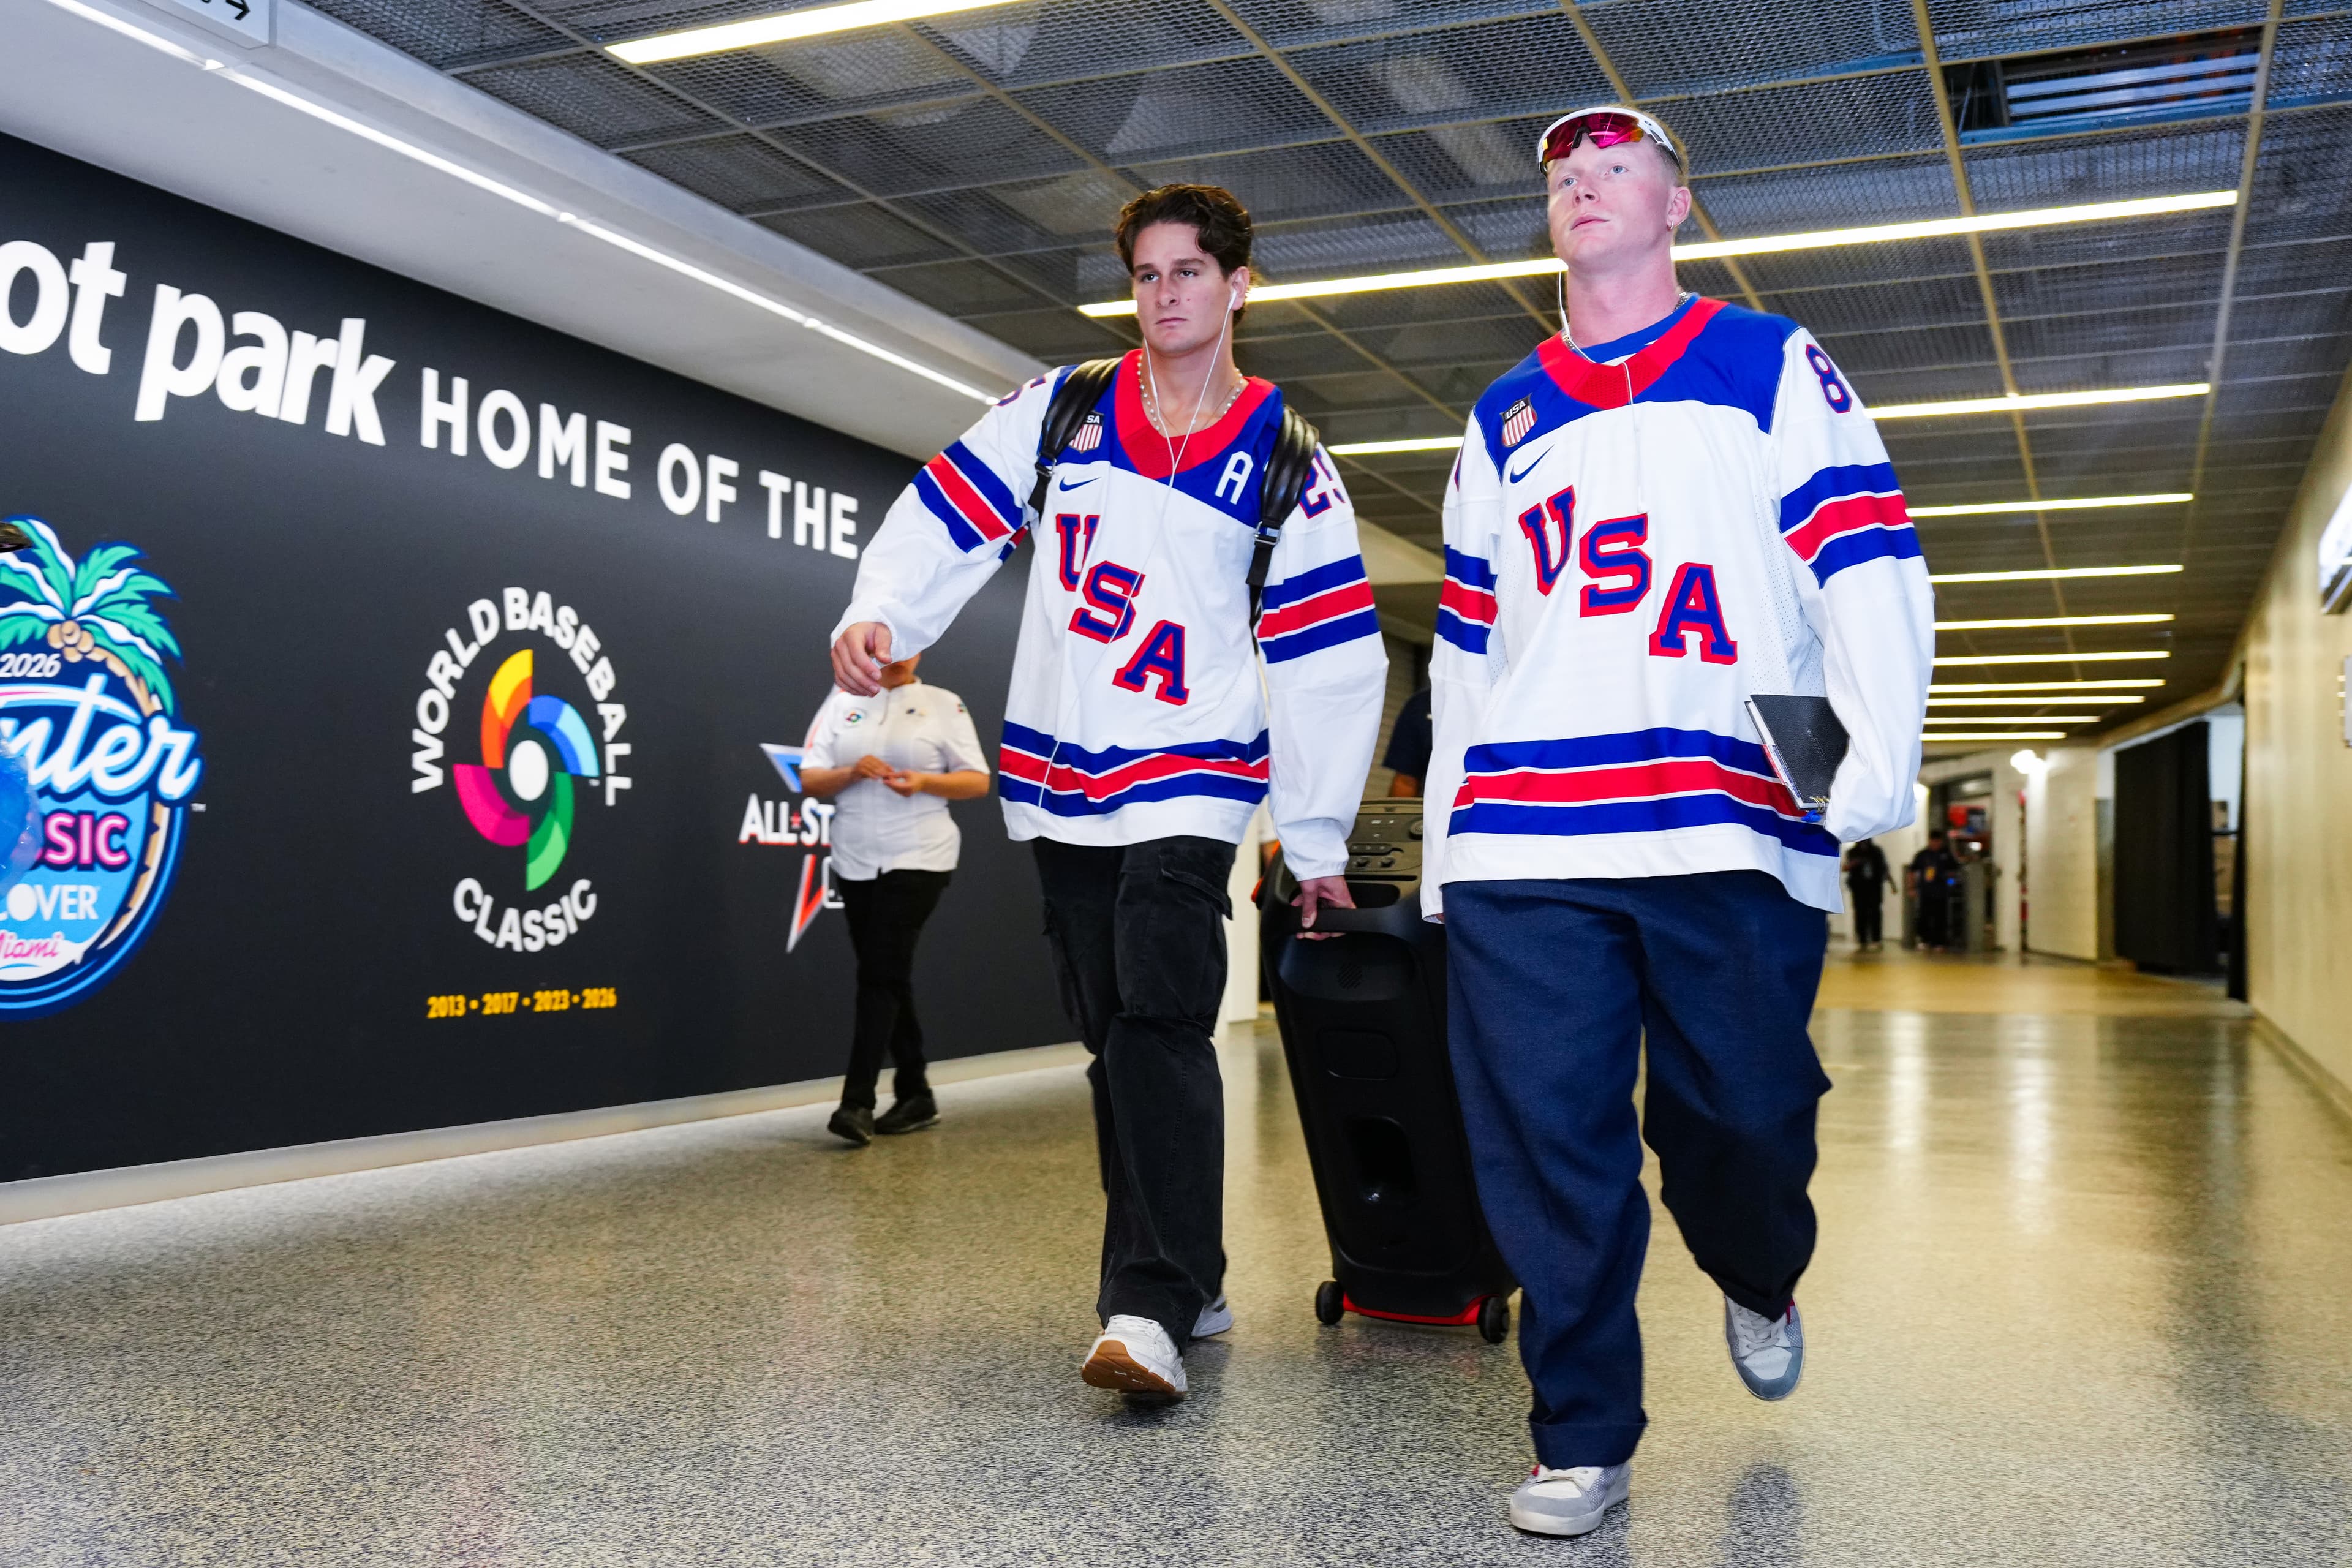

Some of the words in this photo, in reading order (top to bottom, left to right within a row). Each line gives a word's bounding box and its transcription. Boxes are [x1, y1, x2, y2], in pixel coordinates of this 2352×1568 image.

[0, 240, 127, 374] ot
[135, 284, 396, 447] park
[420, 368, 631, 499] HOME
[657, 443, 739, 522] OF
[760, 470, 858, 559] THE
[1087, 415, 1101, 424] SA
[1506, 400, 1526, 420] USA
[1215, 451, 1254, 505] A
[1518, 485, 1738, 665] USA
[1056, 513, 1189, 706] USA
[0, 653, 61, 677] 2026
[412, 599, 500, 793] WORLD
[503, 587, 632, 806] BASEBALL
[35, 815, 129, 865] SIC
[453, 878, 597, 952] CLASSIC
[427, 994, 466, 1019] 2013
[482, 992, 519, 1015] 2017
[533, 990, 570, 1012] 2023
[582, 987, 617, 1009] 2026
